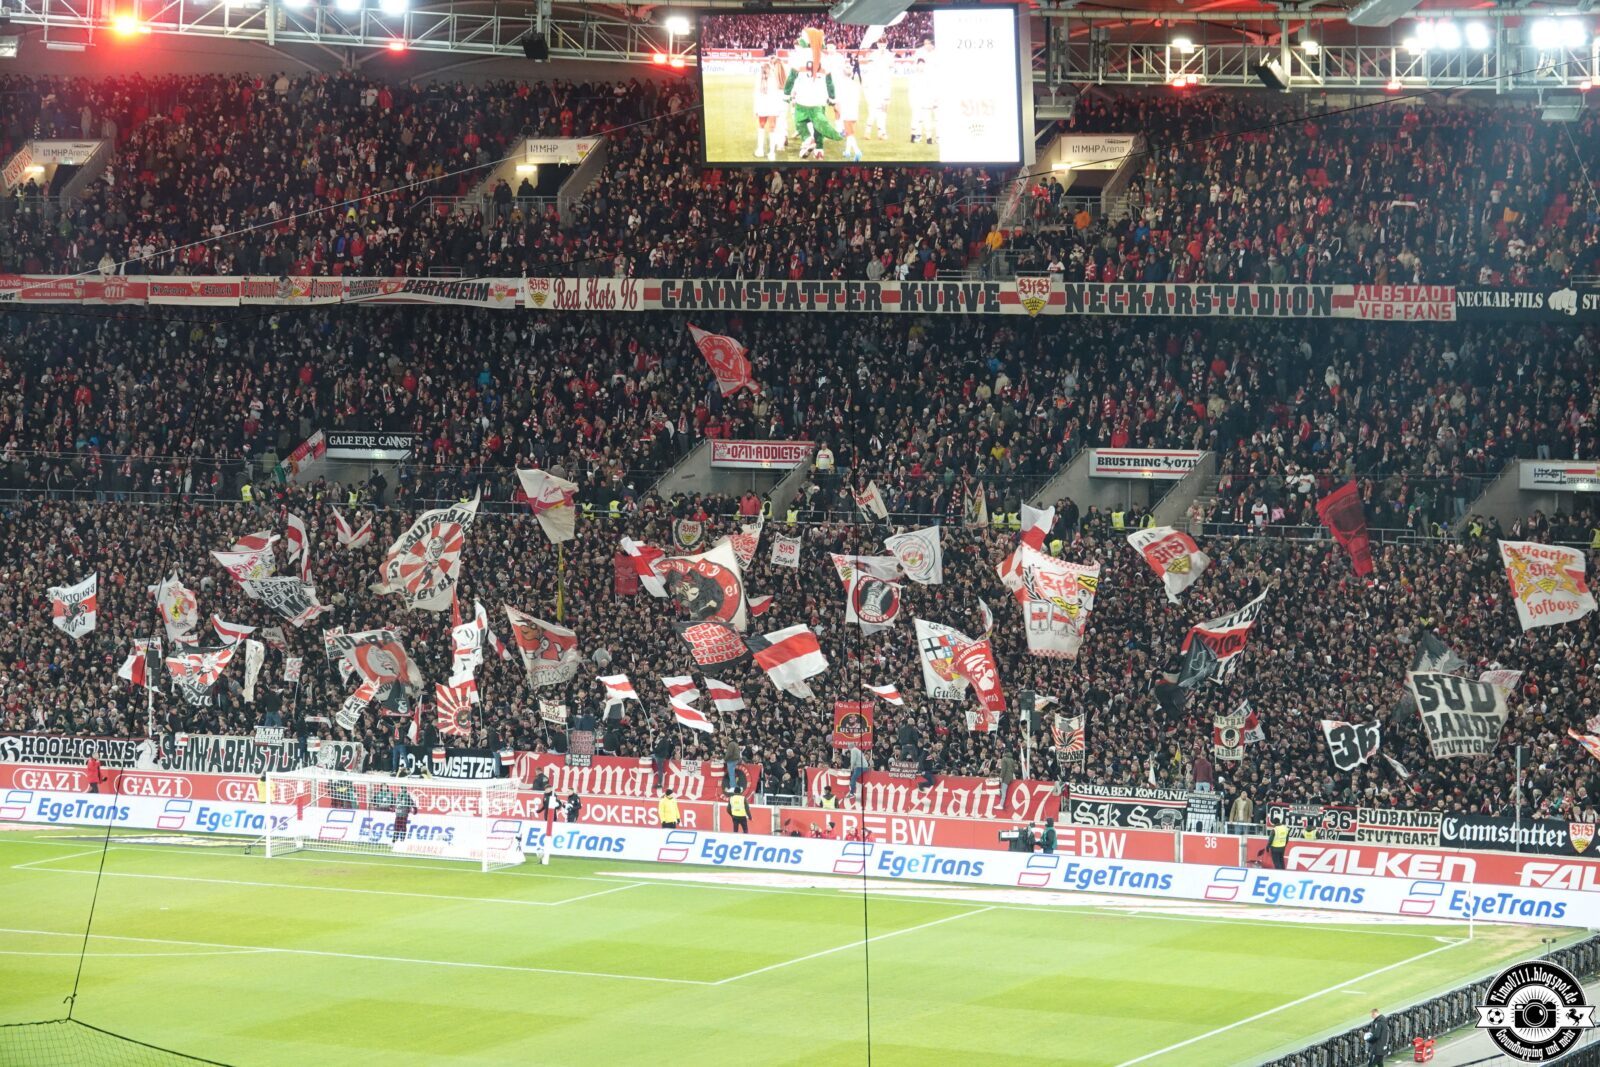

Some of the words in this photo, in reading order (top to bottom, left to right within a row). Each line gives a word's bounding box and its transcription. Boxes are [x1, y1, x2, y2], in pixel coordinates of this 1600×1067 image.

[956, 38, 995, 49] 20:28
[539, 145, 559, 154] MHP
[1081, 145, 1100, 155] MHP
[1101, 145, 1125, 155] Arena
[403, 280, 490, 301] BERKHEIM
[553, 277, 581, 310] Red
[585, 277, 616, 310] Hots
[620, 278, 638, 310] 96
[661, 281, 882, 312] CANNSTATTER
[900, 283, 1000, 313] KURVE
[1065, 285, 1333, 317] NECKARSTADION
[1357, 286, 1455, 302] ALBSTADT
[1456, 291, 1543, 308] NECKAR-FILS
[1358, 303, 1453, 320] VFB-FANS
[329, 436, 377, 447] GALEERE
[756, 447, 801, 460] ADDICTS
[1097, 456, 1161, 468] BRUSTRING
[1174, 459, 1198, 469] 0711
[1425, 713, 1502, 741] BANDE
[20, 736, 136, 760] HOOLIGANS
[812, 769, 1006, 820] Cannstatt
[1012, 783, 1055, 821] 97
[1069, 782, 1133, 797] SCHWABEN
[1134, 787, 1188, 802] KOMPANIE
[37, 796, 130, 824] EgeTrans
[1326, 811, 1352, 829] 36
[1203, 836, 1218, 849] 36
[1357, 829, 1438, 846] STUTTGART
[1441, 817, 1567, 848] Cannstatter
[701, 838, 804, 867] EgeTrans
[878, 850, 985, 878] EgeTrans
[1285, 845, 1478, 885] FALKEN
[1063, 862, 1173, 890] EgeTrans
[1252, 875, 1366, 905] EgeTrans
[1449, 889, 1568, 918] EgeTrans
